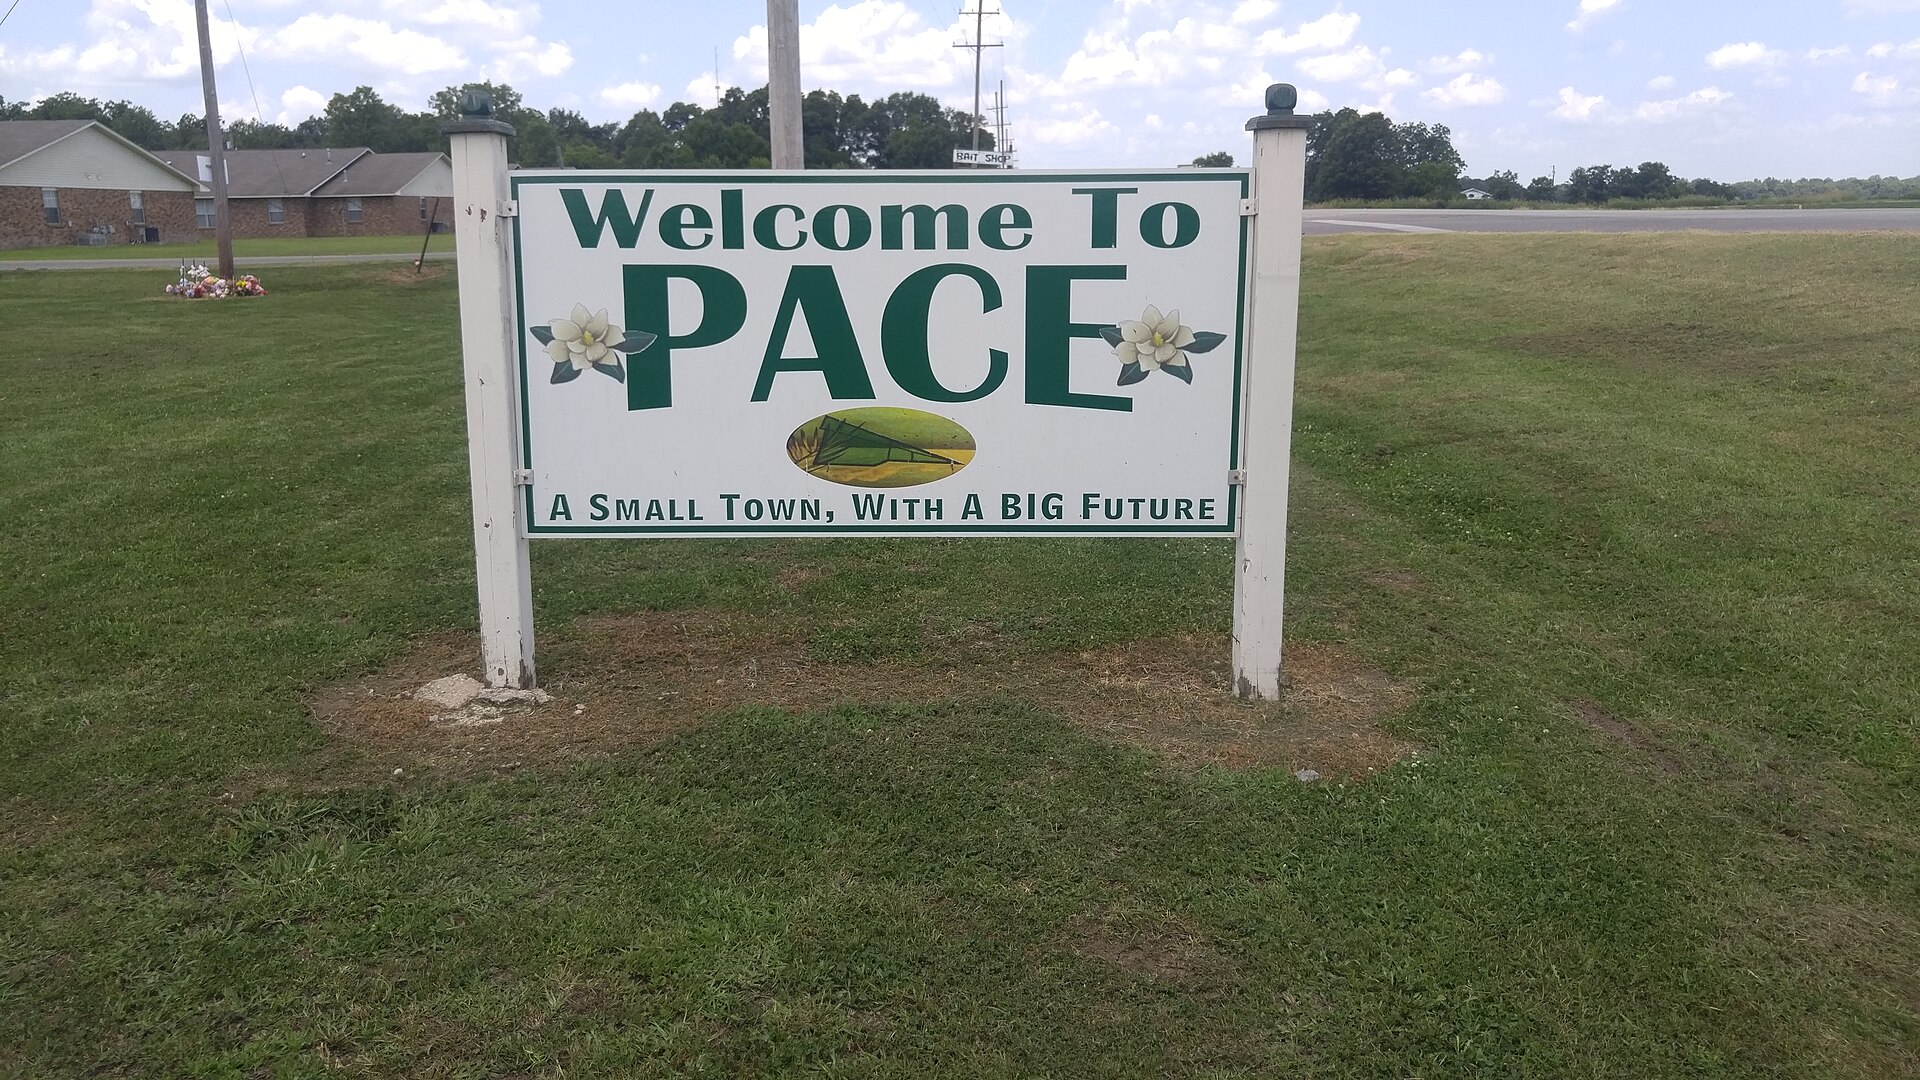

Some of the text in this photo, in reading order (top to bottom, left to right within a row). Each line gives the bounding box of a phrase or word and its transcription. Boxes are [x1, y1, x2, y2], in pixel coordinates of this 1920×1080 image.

[985, 154, 1011, 163] SHOP
[558, 187, 1201, 251] Welcome To
[622, 262, 1134, 413] PACE
[549, 492, 1215, 524] A SMALL TOWN, WITH A BIG FUTURE
